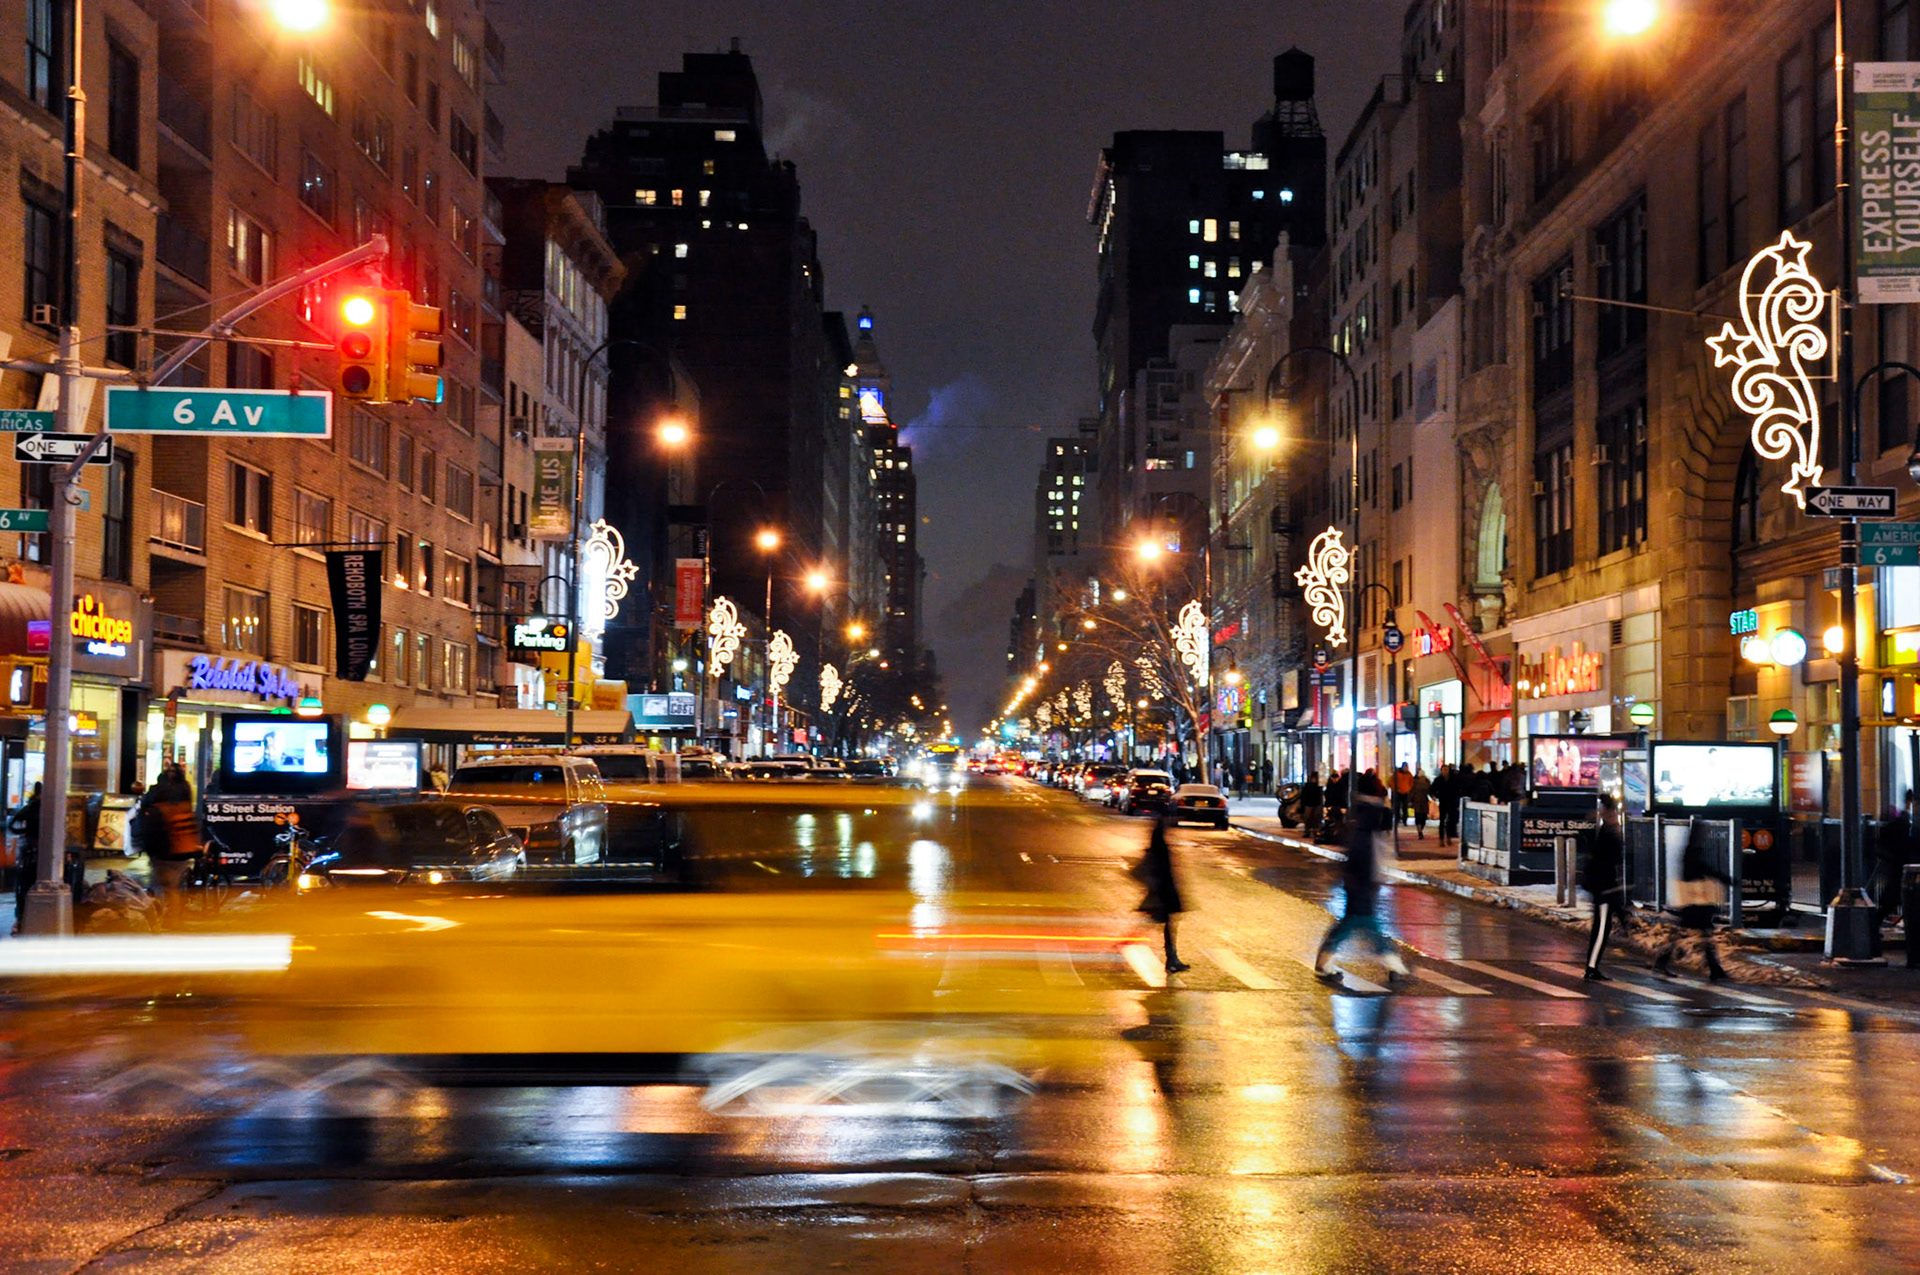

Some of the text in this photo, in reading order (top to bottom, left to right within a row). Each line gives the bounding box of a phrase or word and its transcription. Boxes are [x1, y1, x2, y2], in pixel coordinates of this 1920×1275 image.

[1861, 129, 1892, 252] EXPRESS
[1893, 112, 1920, 252] YOURSELF
[173, 398, 263, 426] 6 Av
[25, 440, 57, 453] ONE
[541, 458, 560, 480] US
[538, 485, 560, 520] LIKE
[1818, 495, 1884, 507] ONE WAY
[0, 511, 30, 529] 6 AV
[1874, 547, 1903, 564] 6 AV
[344, 554, 367, 609] REHOBOTH
[71, 594, 132, 646] chickpea
[348, 614, 368, 632] SPA
[1730, 608, 1758, 635] STAR
[514, 633, 566, 651] Parking
[192, 655, 257, 692] Rehoboth
[207, 803, 295, 814] 14 Street Station
[1524, 820, 1534, 829] 14
[1536, 820, 1564, 829] Street
[1757, 834, 1769, 846] M
